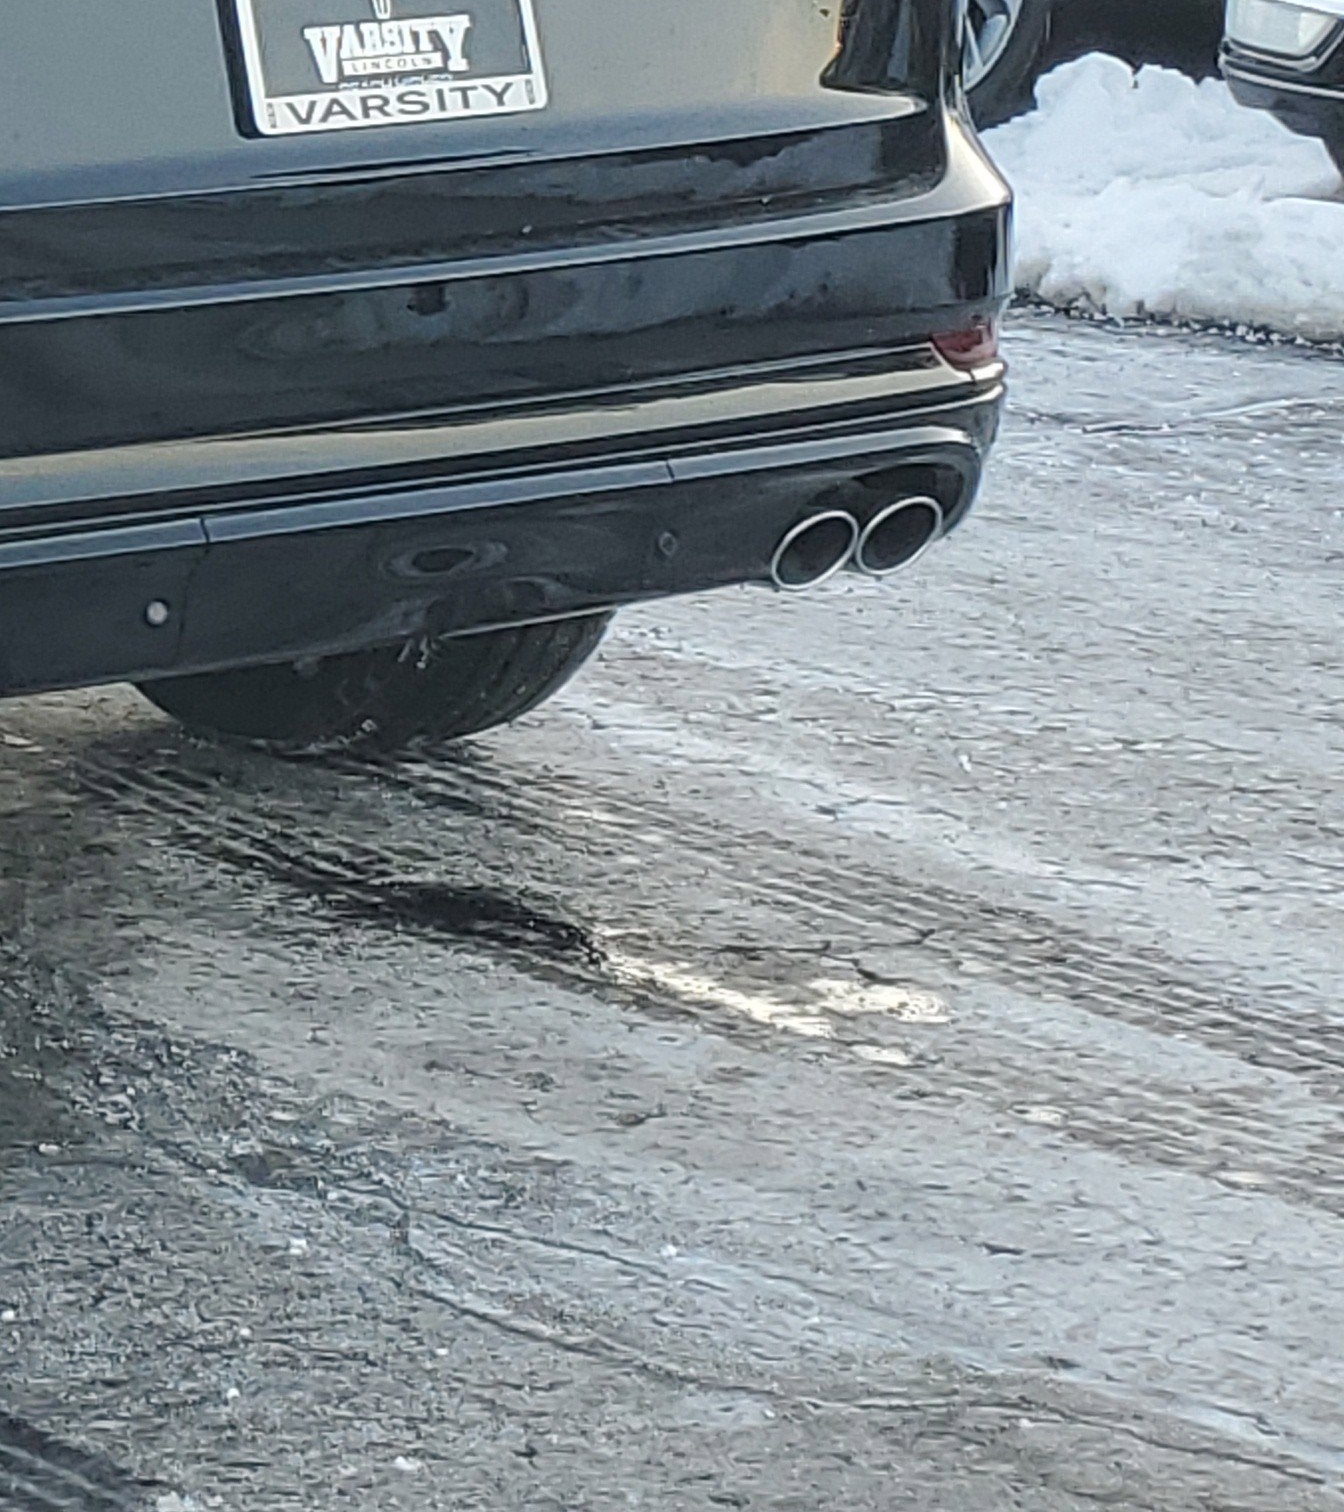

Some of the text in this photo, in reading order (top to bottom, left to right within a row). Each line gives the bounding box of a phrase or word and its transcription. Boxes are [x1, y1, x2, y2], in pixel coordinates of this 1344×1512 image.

[303, 14, 472, 84] VARSITY
[350, 57, 433, 74] LINCOLN
[285, 82, 515, 126] VARSITY
